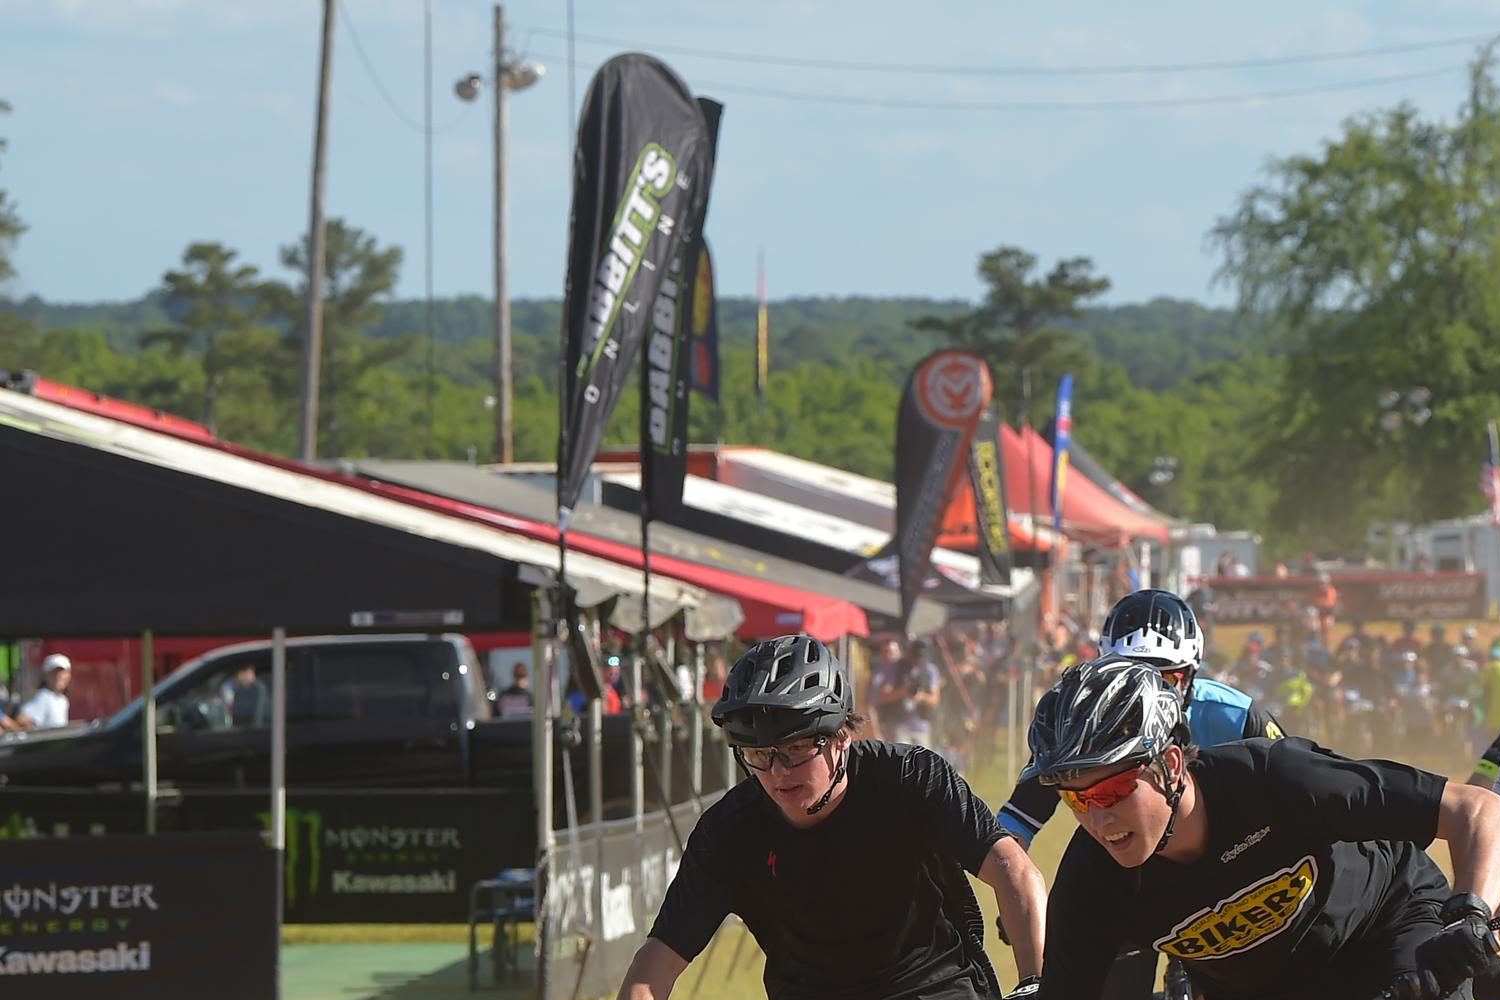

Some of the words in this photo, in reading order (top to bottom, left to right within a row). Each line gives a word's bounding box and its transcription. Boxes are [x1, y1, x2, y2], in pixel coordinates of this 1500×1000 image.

[325, 826, 462, 848] MONSTER
[332, 870, 456, 893] Kawasaki
[0, 882, 158, 918] ONSTER
[1172, 875, 1308, 955] BIKERS
